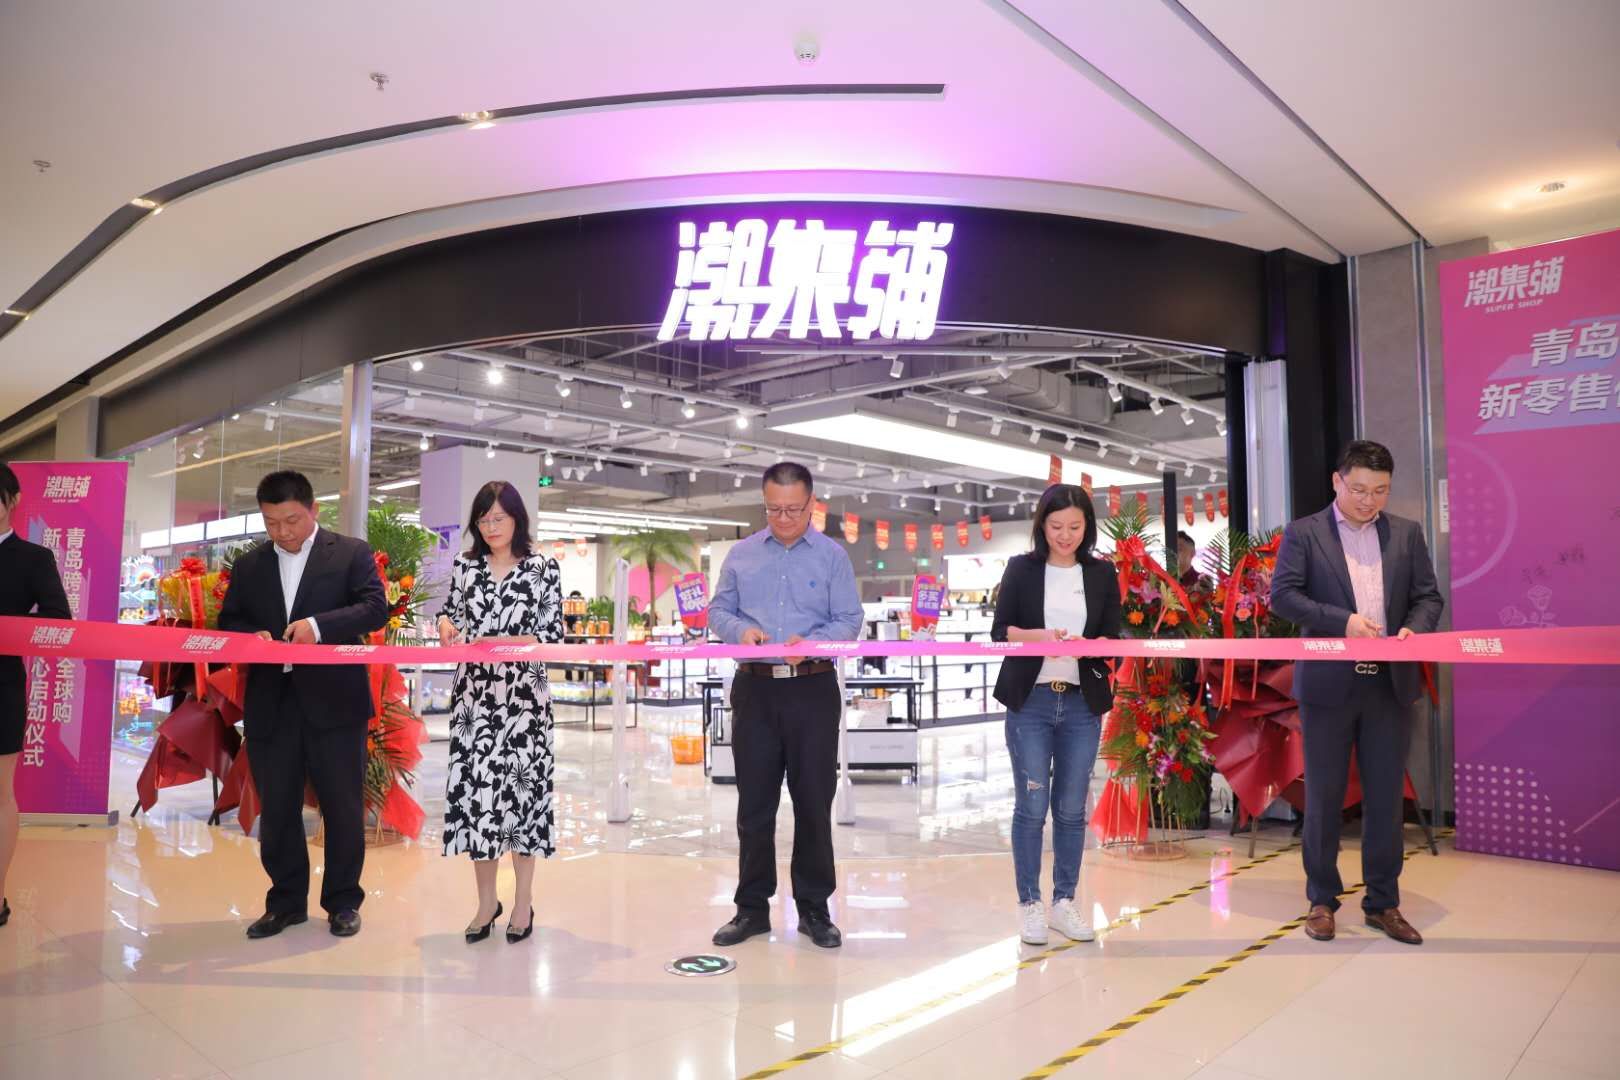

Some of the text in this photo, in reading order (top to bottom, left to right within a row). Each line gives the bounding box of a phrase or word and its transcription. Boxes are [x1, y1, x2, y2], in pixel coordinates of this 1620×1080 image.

[656, 218, 954, 341] 潮集铺
[1464, 256, 1565, 308] 潮集铺
[1485, 298, 1543, 313] SUPER SHOP
[1530, 321, 1620, 368] 青岛
[1478, 372, 1620, 420] 新零售
